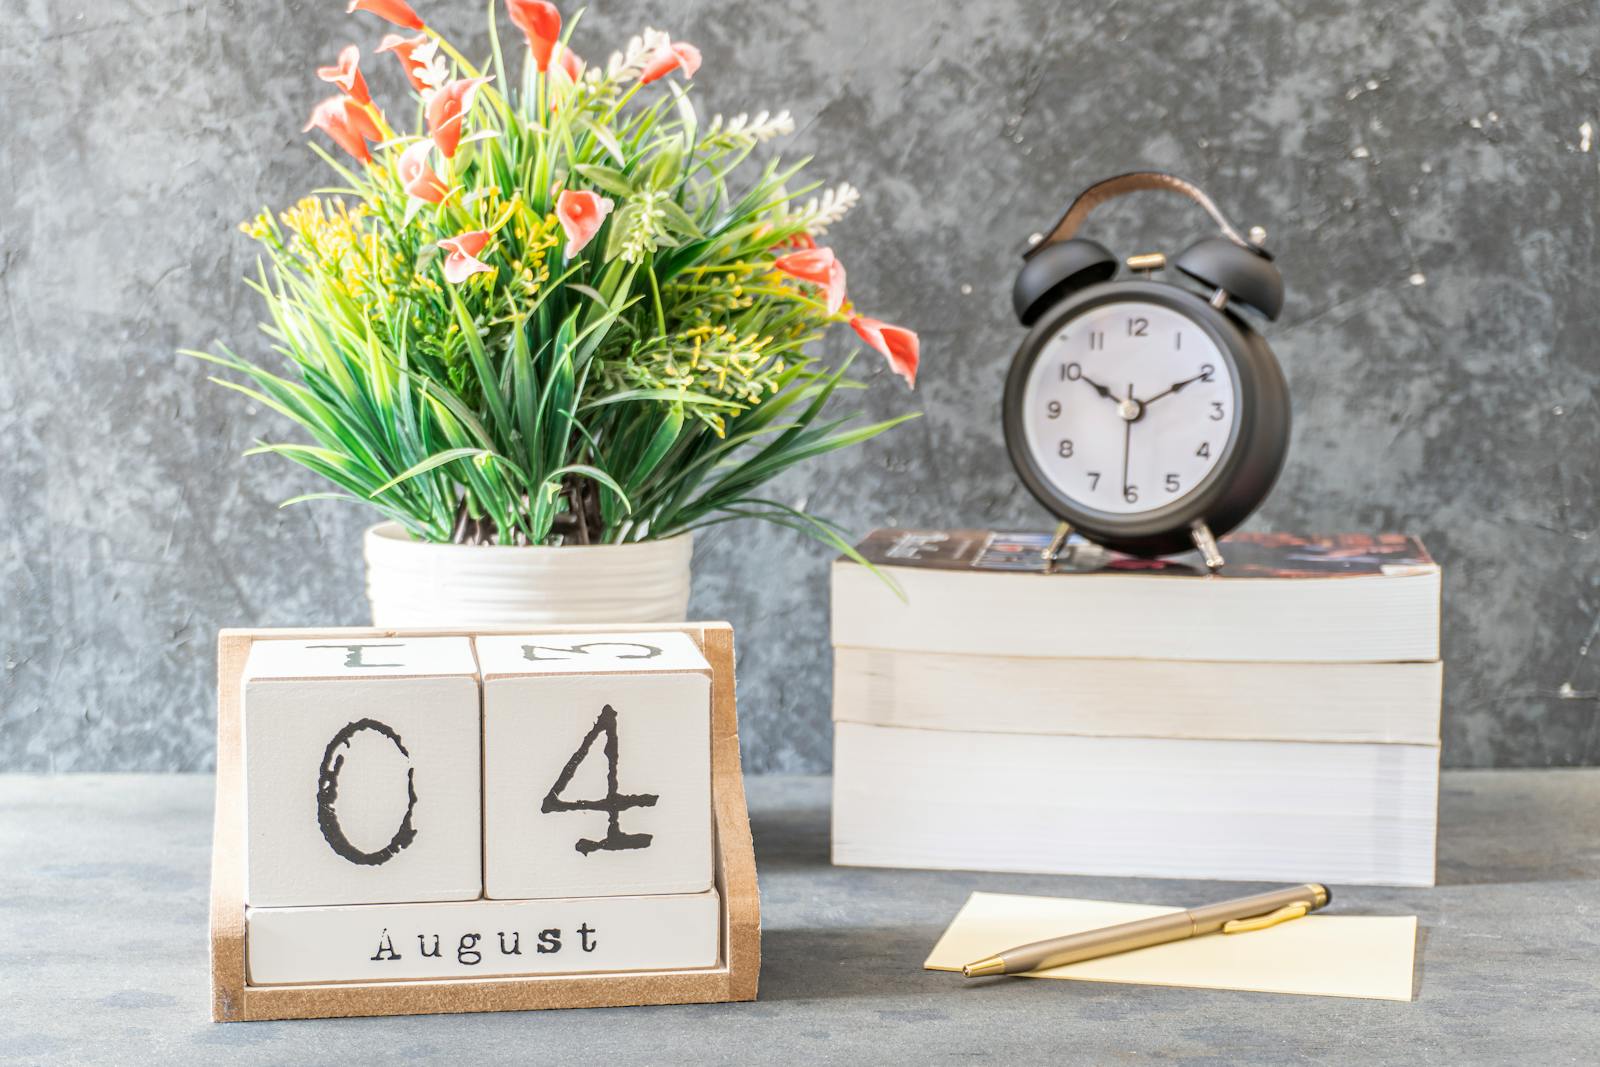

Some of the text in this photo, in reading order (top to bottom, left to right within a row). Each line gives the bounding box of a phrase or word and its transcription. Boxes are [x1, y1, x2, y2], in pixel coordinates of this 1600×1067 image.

[1128, 318, 1149, 337] 12
[1091, 332, 1104, 350] 11
[1175, 332, 1182, 350] 1
[1060, 363, 1082, 382] 10
[1201, 365, 1215, 383] 2
[1048, 401, 1061, 419] 9
[1210, 402, 1225, 421] 3
[1059, 440, 1073, 458] 8
[1196, 442, 1210, 460] 4
[1087, 472, 1101, 491] 7
[1165, 474, 1180, 493] 5
[1125, 486, 1138, 503] 6
[370, 922, 597, 965] August
